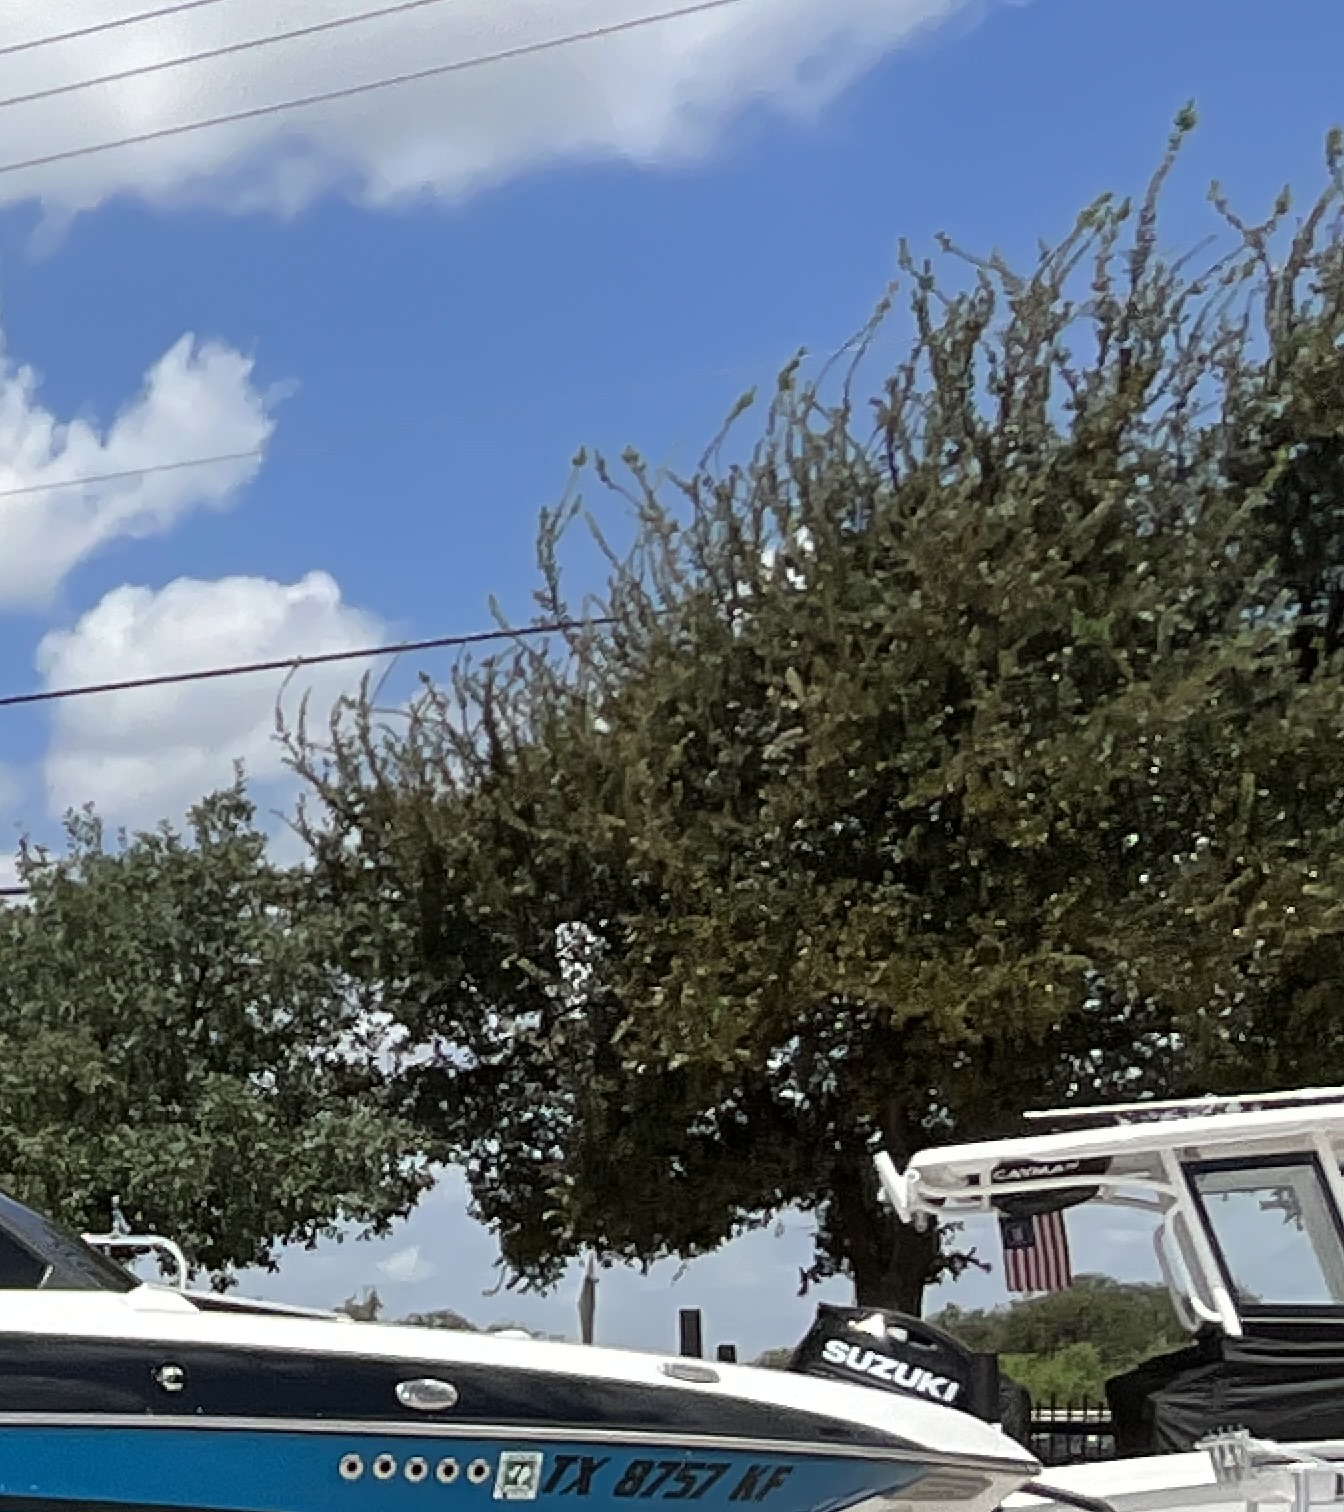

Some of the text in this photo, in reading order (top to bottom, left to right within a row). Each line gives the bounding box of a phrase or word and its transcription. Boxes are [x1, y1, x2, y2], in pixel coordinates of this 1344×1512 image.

[822, 1340, 960, 1402] SUZUKI
[541, 1454, 611, 1496] TX
[613, 1458, 732, 1499] 8757
[728, 1463, 795, 1502] KF
